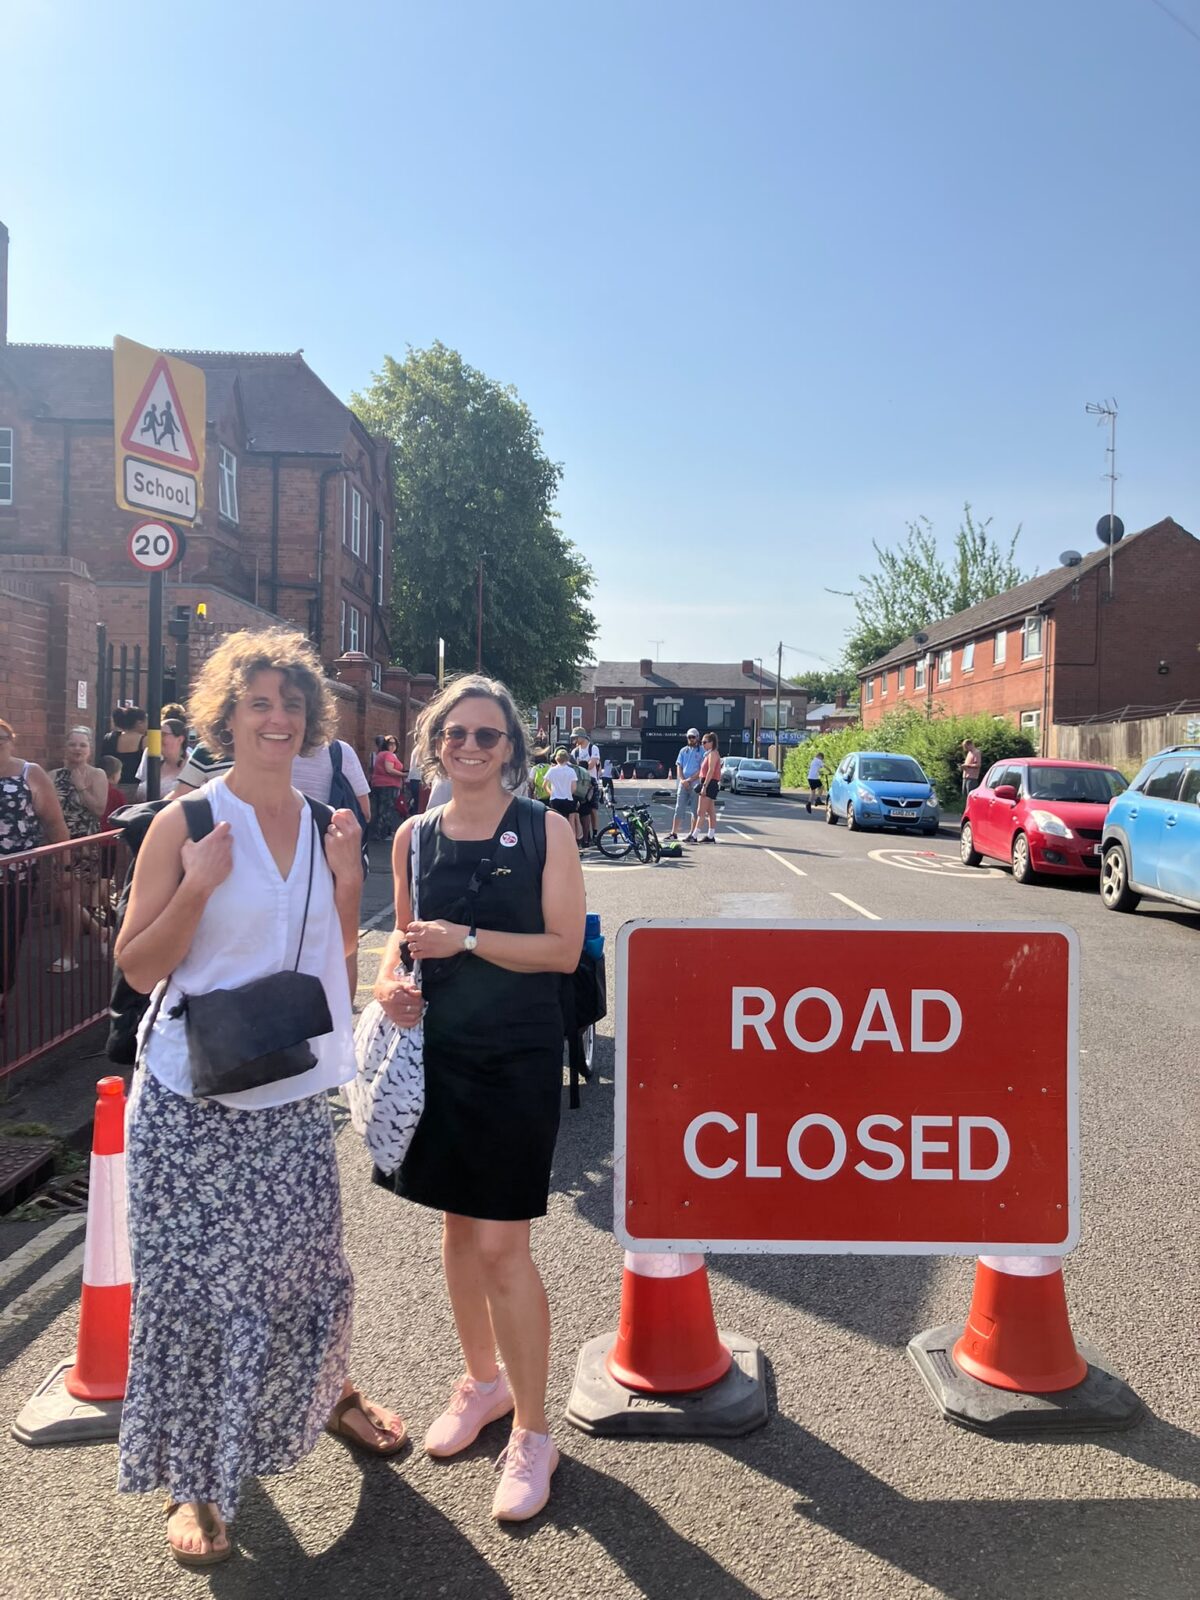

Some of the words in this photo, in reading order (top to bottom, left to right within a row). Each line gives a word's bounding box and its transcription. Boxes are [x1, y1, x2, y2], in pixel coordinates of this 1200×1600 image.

[133, 471, 190, 506] School
[135, 534, 170, 556] 20
[731, 986, 962, 1053] ROAD
[683, 1111, 1011, 1181] CLOSED
